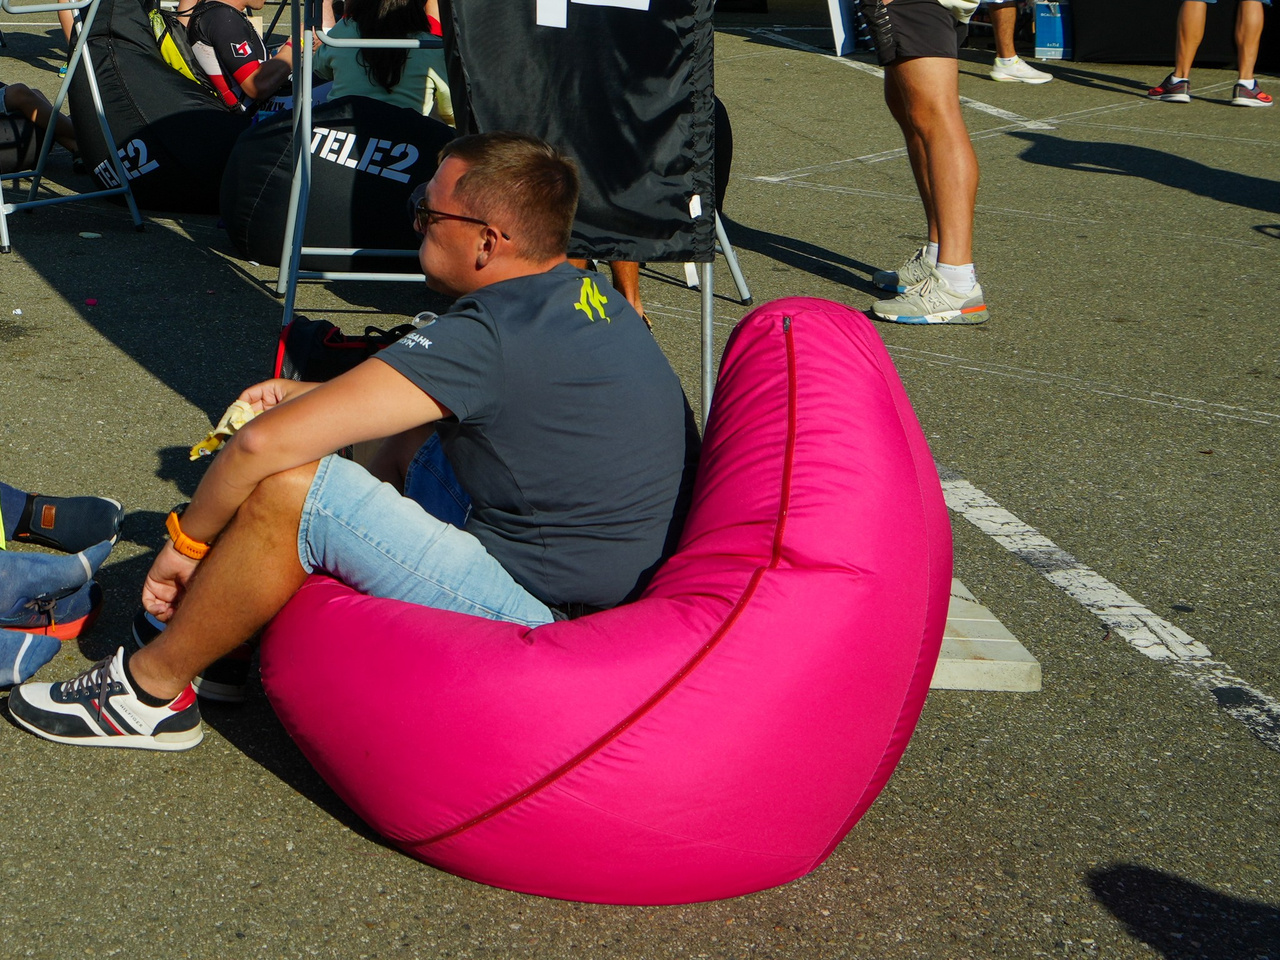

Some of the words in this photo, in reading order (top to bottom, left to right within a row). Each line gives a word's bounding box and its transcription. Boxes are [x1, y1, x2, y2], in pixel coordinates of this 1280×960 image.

[93, 138, 160, 189] TELE2
[310, 126, 419, 184] TELE2
[119, 704, 144, 728] HILFIGER
